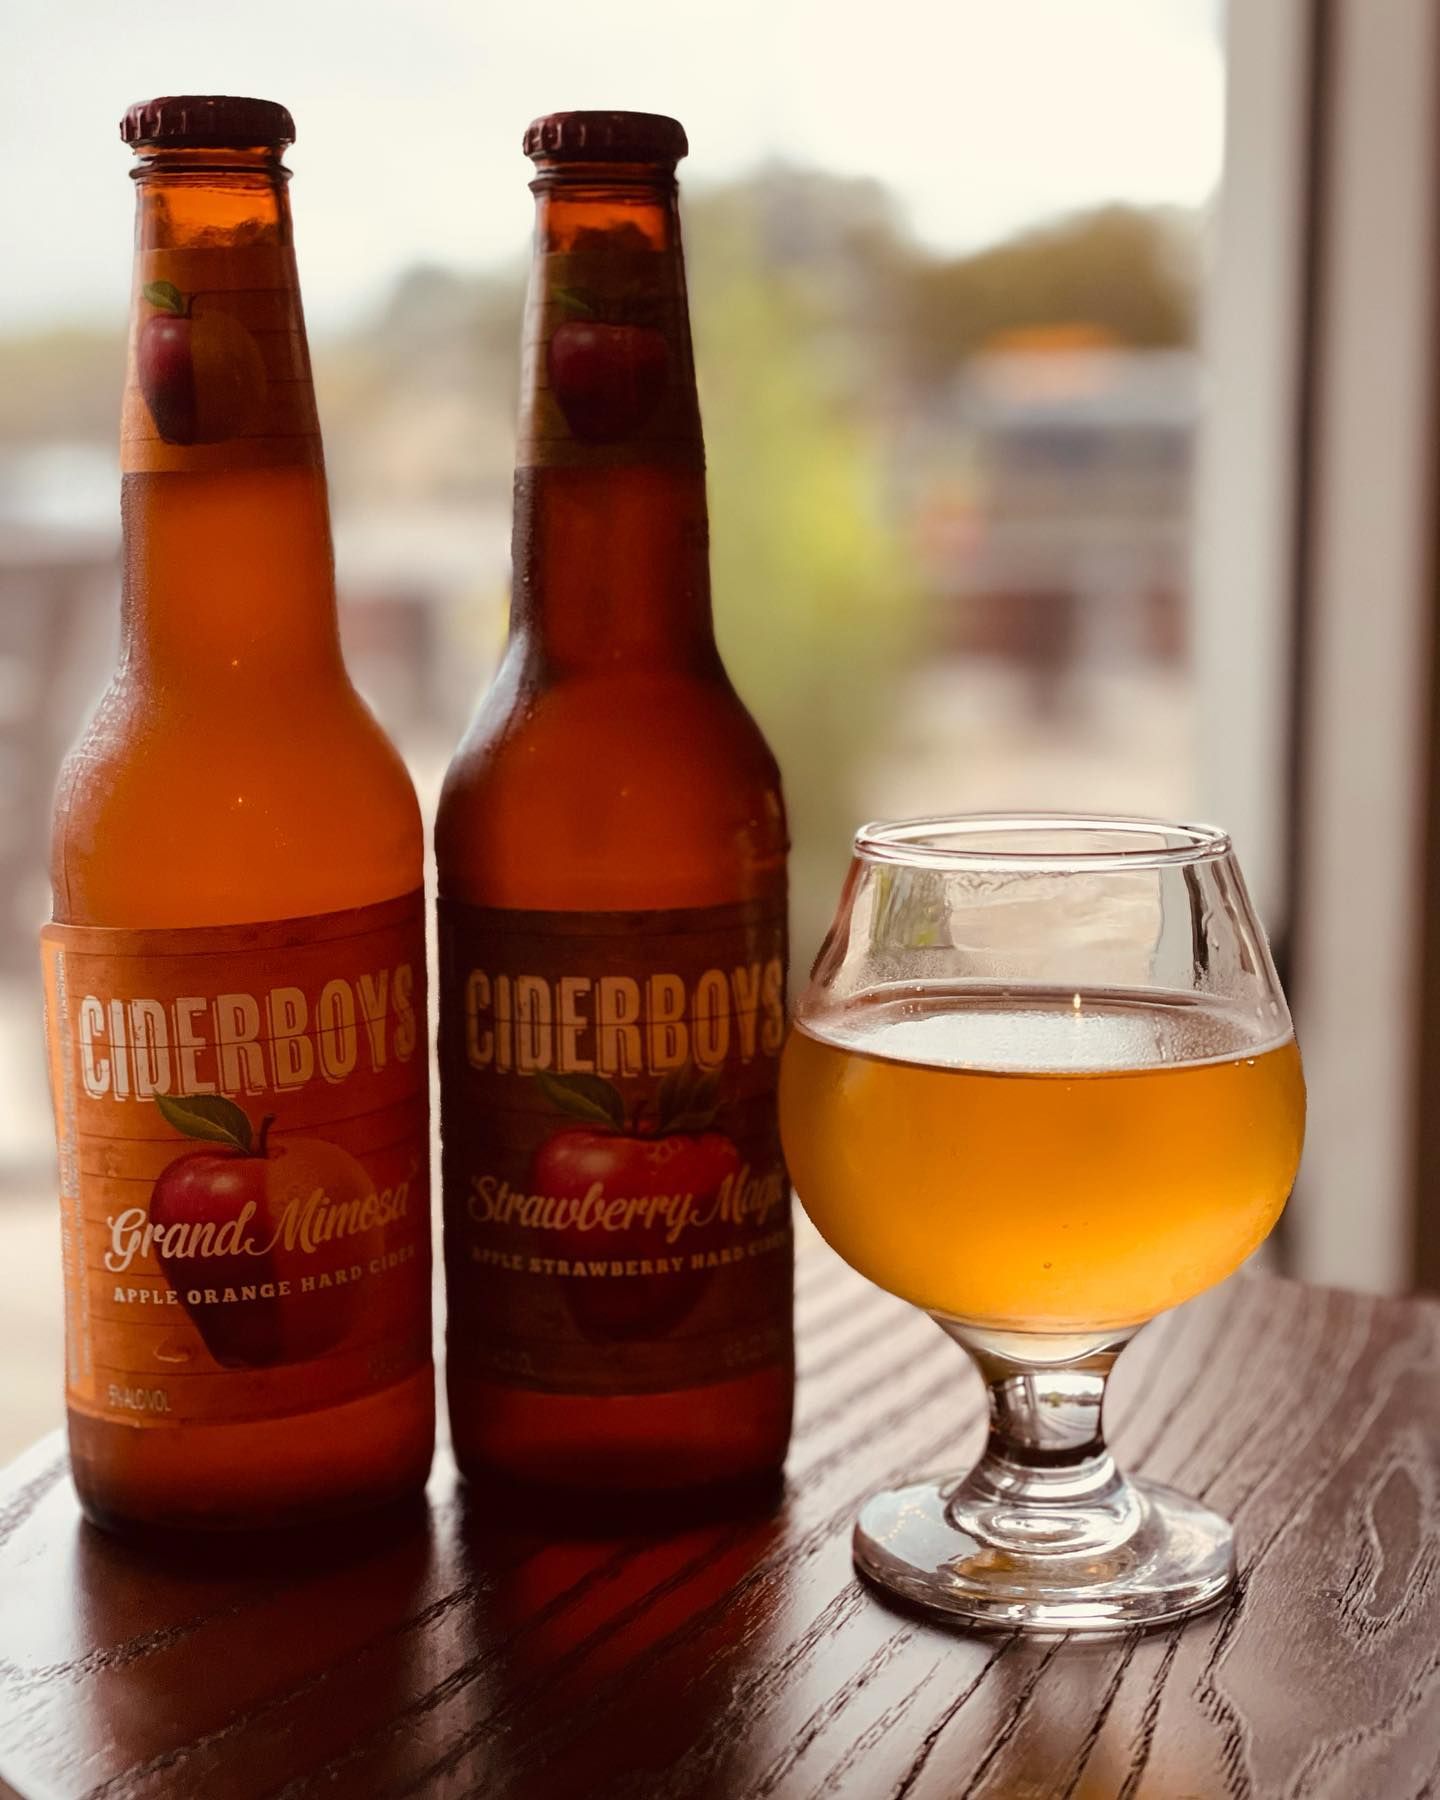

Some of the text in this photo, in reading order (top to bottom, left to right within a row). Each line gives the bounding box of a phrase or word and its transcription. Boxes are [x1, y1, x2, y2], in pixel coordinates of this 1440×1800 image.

[79, 962, 416, 1102] CIDERBOYS
[465, 957, 785, 1078] CIDERBOYS
[104, 1182, 409, 1273] Grand Mimosa
[467, 1174, 695, 1245] Strawberry
[114, 1286, 179, 1305] APPLE
[187, 1280, 293, 1306] ORANGE
[301, 1266, 363, 1292] HARD
[528, 1256, 685, 1278] STRAWBERRY
[690, 1247, 744, 1270] HARD
